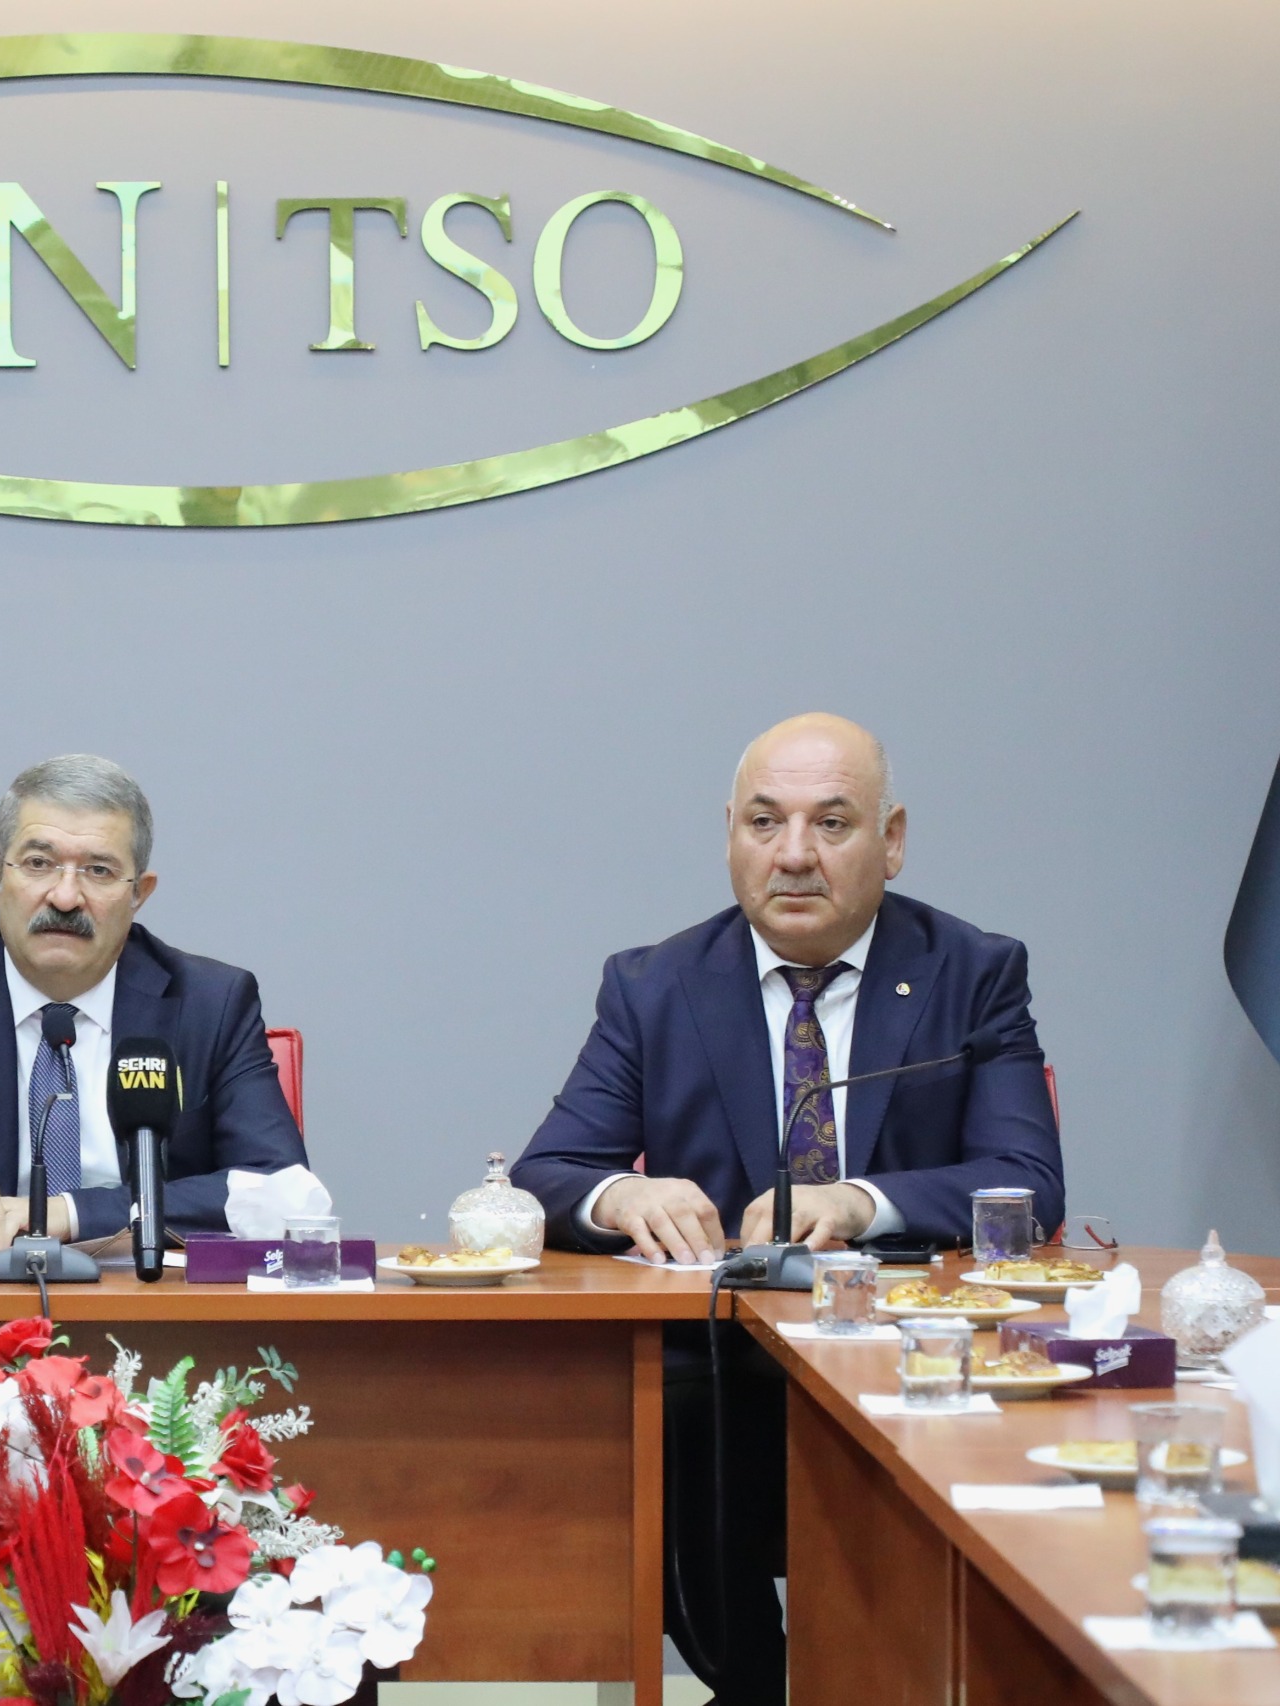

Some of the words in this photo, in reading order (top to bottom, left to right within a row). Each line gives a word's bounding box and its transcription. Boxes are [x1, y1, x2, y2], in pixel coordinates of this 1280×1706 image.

[275, 189, 686, 353] TSO
[118, 1070, 166, 1090] VAN
[264, 1248, 284, 1263] Selp
